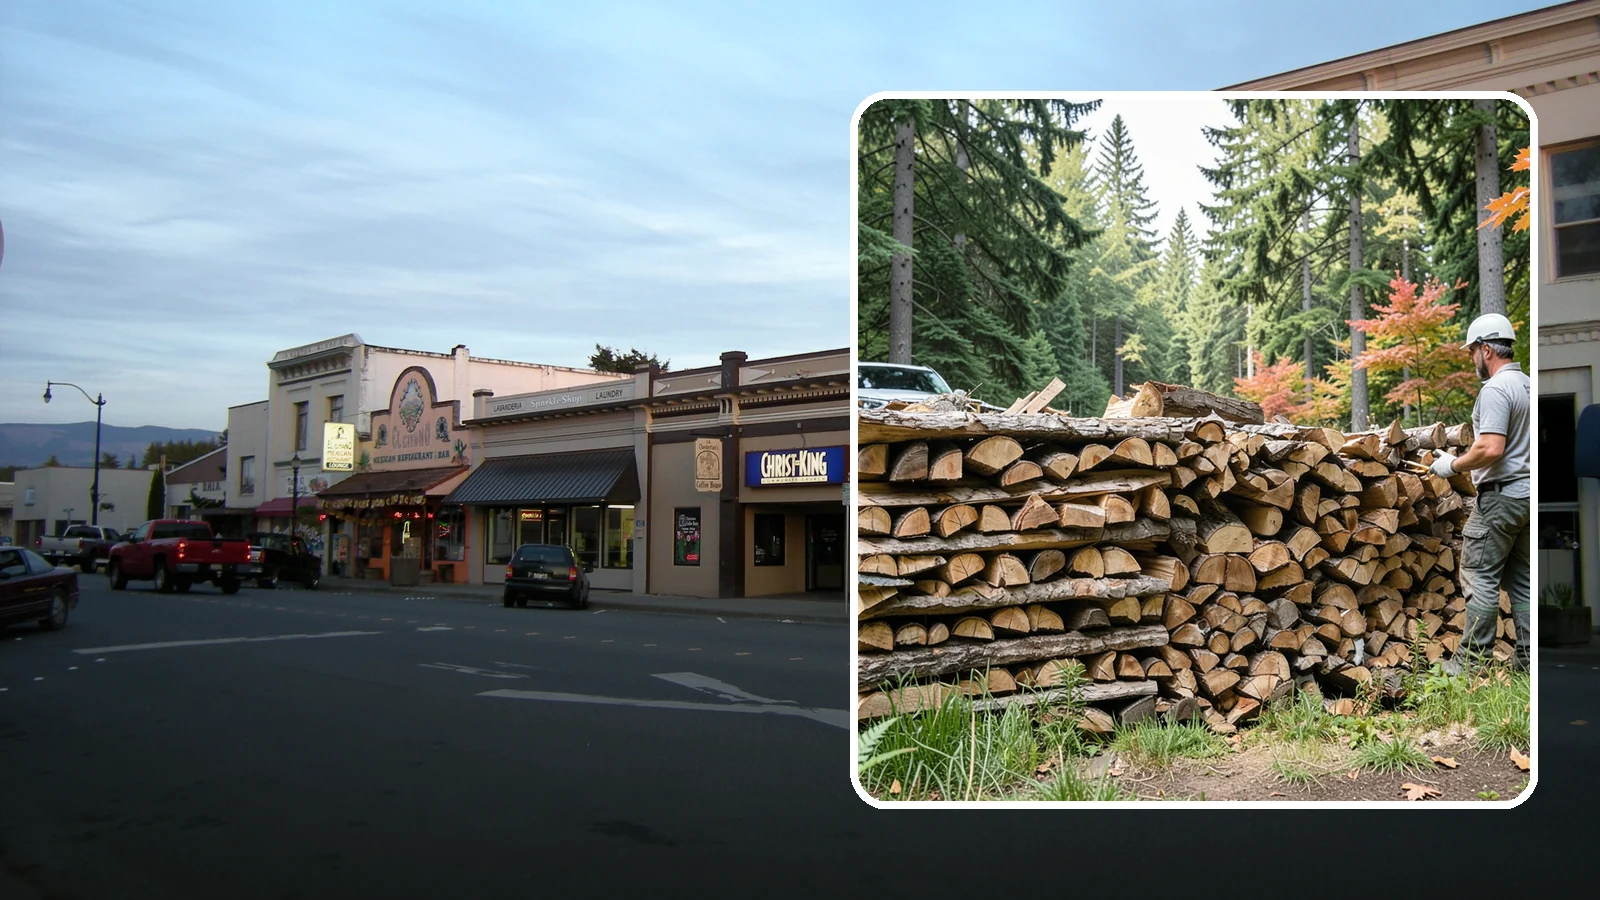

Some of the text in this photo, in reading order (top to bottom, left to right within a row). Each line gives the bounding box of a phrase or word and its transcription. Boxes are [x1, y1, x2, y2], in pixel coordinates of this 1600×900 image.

[493, 388, 624, 412] LAVANDERIA Sparkle Shop LAUNDRY
[373, 450, 450, 464] MEXICAN RESTAURANT BAR
[760, 450, 827, 478] CHRIST KING
